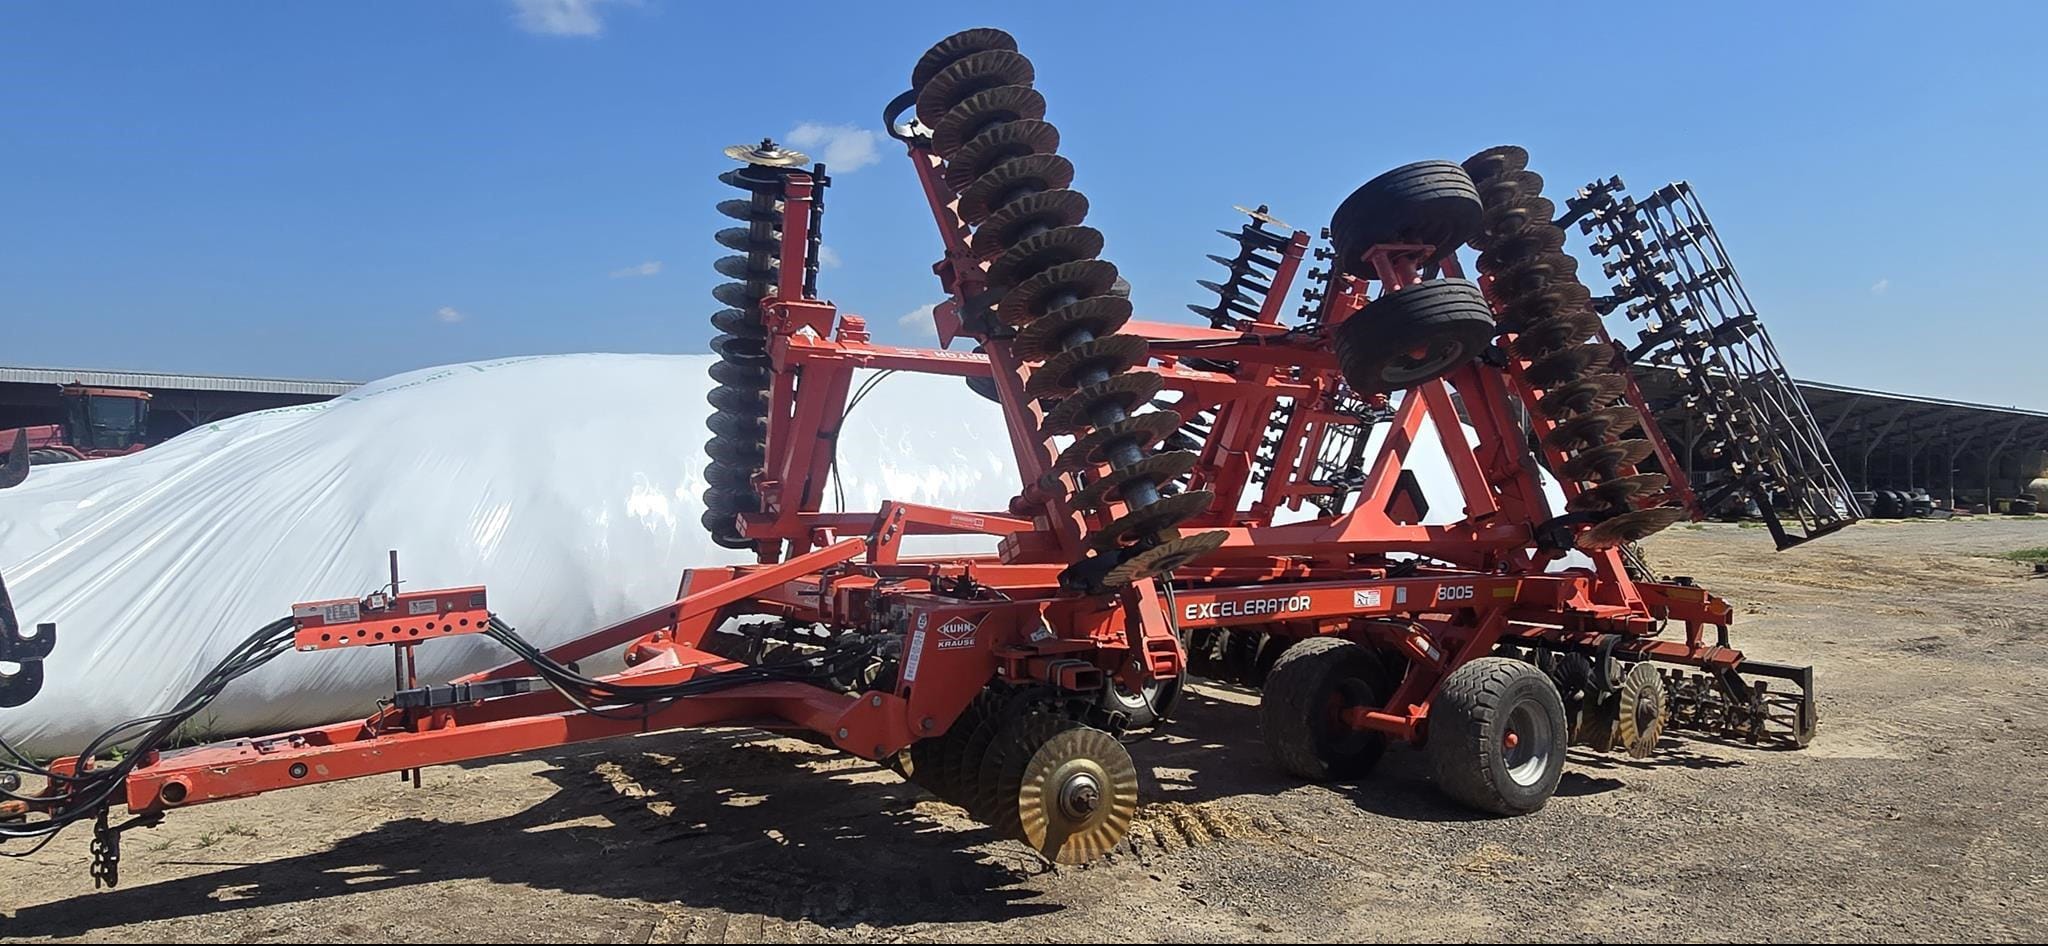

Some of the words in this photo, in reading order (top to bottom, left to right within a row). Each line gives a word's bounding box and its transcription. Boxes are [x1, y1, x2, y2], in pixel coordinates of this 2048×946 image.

[1437, 585, 1474, 600] 8005
[1185, 595, 1312, 619] EXCELERATOR
[943, 623, 972, 633] KUHN
[937, 639, 976, 648] KRAUSE
